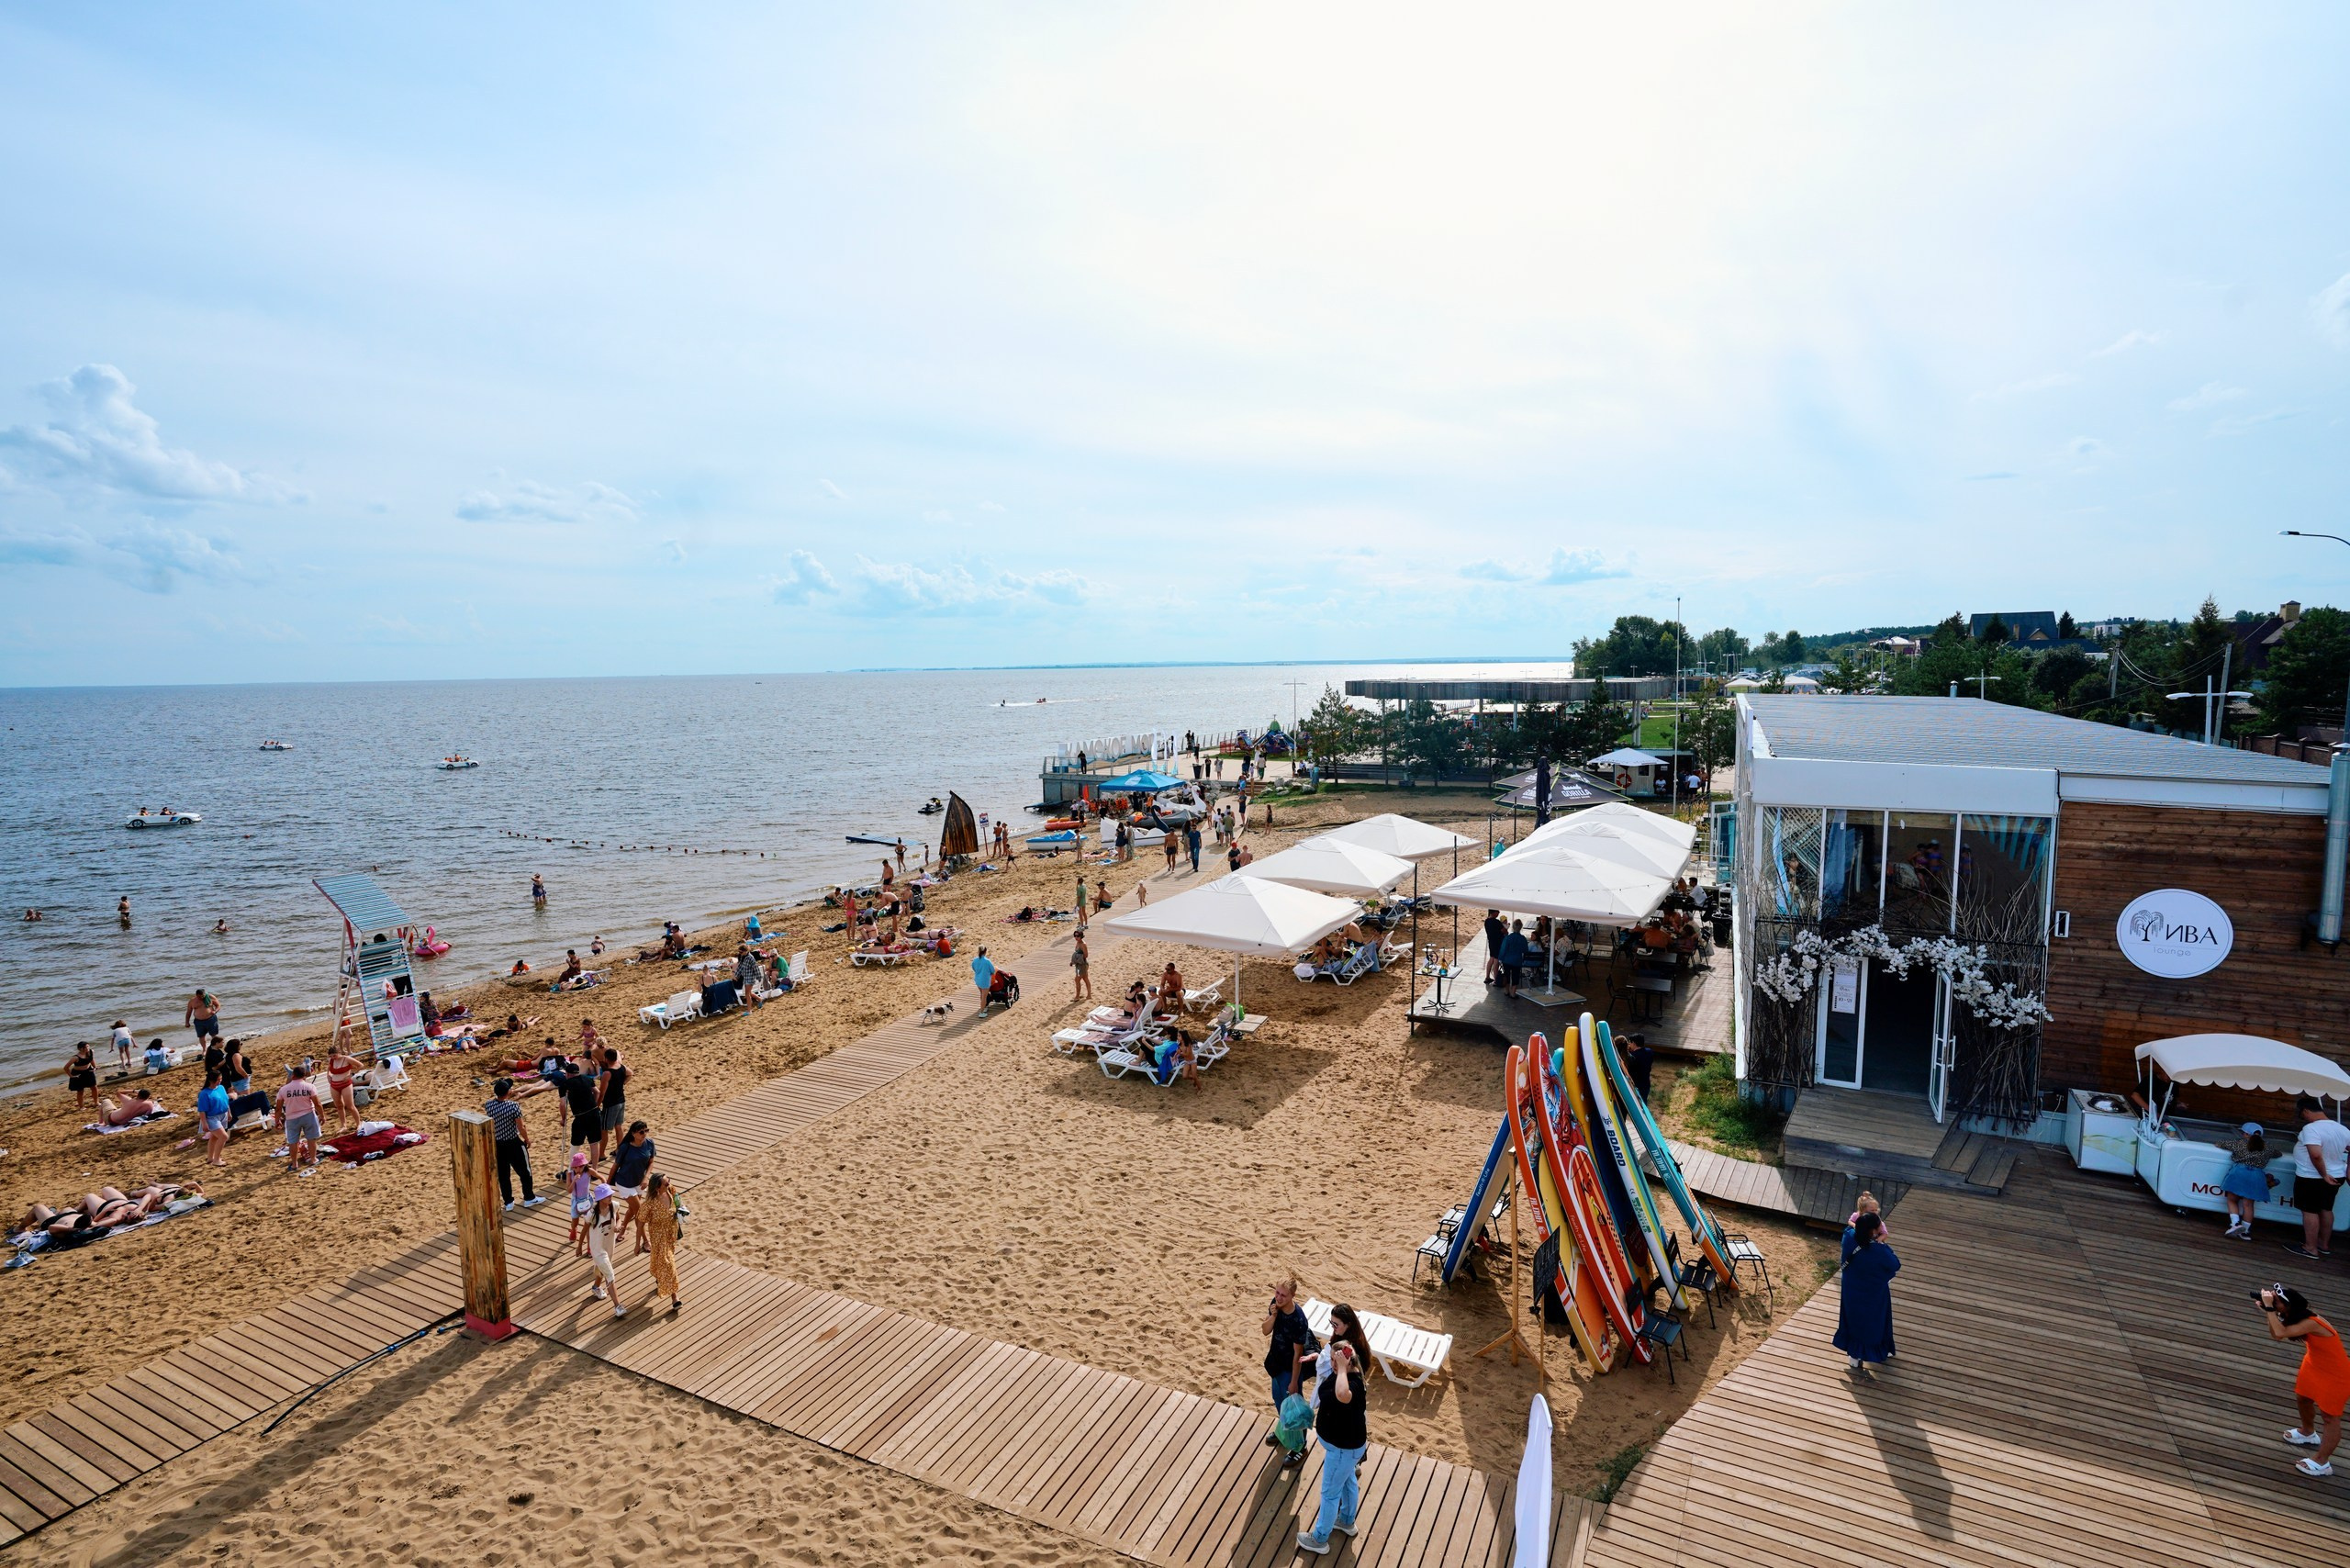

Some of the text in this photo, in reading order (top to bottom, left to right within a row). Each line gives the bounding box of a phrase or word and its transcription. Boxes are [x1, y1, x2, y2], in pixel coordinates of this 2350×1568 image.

[1561, 790, 1592, 798] GORILLA
[2166, 924, 2218, 946] ИВА
[2154, 946, 2191, 957] lounge
[1607, 1129, 1626, 1167] BOARD
[1651, 1149, 1667, 1170] ALOHA
[1529, 1197, 1543, 1223] ALOHA
